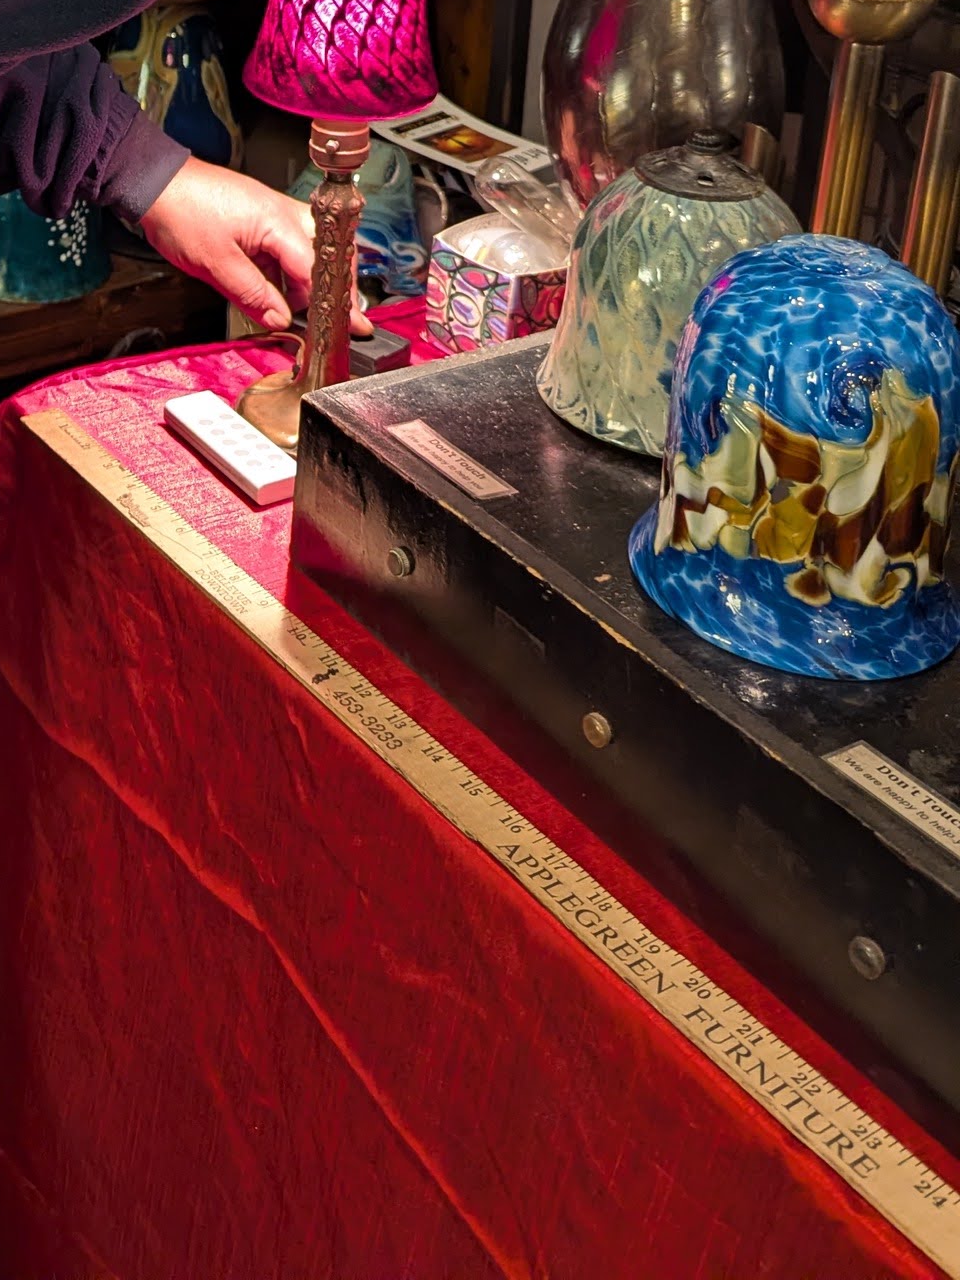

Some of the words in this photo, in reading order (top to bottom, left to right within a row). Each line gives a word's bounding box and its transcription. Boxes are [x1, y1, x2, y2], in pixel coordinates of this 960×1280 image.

[428, 438, 456, 458] Don't
[455, 457, 487, 480] Touch
[195, 569, 248, 614] DOWNTOWN
[208, 568, 252, 605] BELLEVUE
[332, 689, 403, 751] 453-3233
[844, 757, 863, 772] We
[863, 773, 882, 786] are
[882, 786, 917, 810] happy
[916, 810, 929, 820] to
[929, 820, 955, 838] help
[876, 765, 922, 797] Don't
[150, 504, 161, 512] 5
[175, 527, 186, 535] 6
[229, 574, 240, 582] 8
[259, 600, 269, 608] 9
[351, 683, 372, 698] 12
[385, 713, 407, 730] 13
[421, 745, 444, 764] 14
[459, 779, 484, 797] 15
[498, 814, 523, 834] 16
[542, 851, 568, 872] 17
[585, 891, 611, 913] 18
[632, 933, 662, 956] 19
[683, 977, 712, 1000] 20
[736, 1023, 764, 1047] 21
[791, 1072, 822, 1097] 22
[849, 1124, 883, 1150] 23
[913, 1180, 948, 1208] 24
[496, 840, 677, 996] APPLEGREEN
[683, 1005, 882, 1180] FURNITURE
